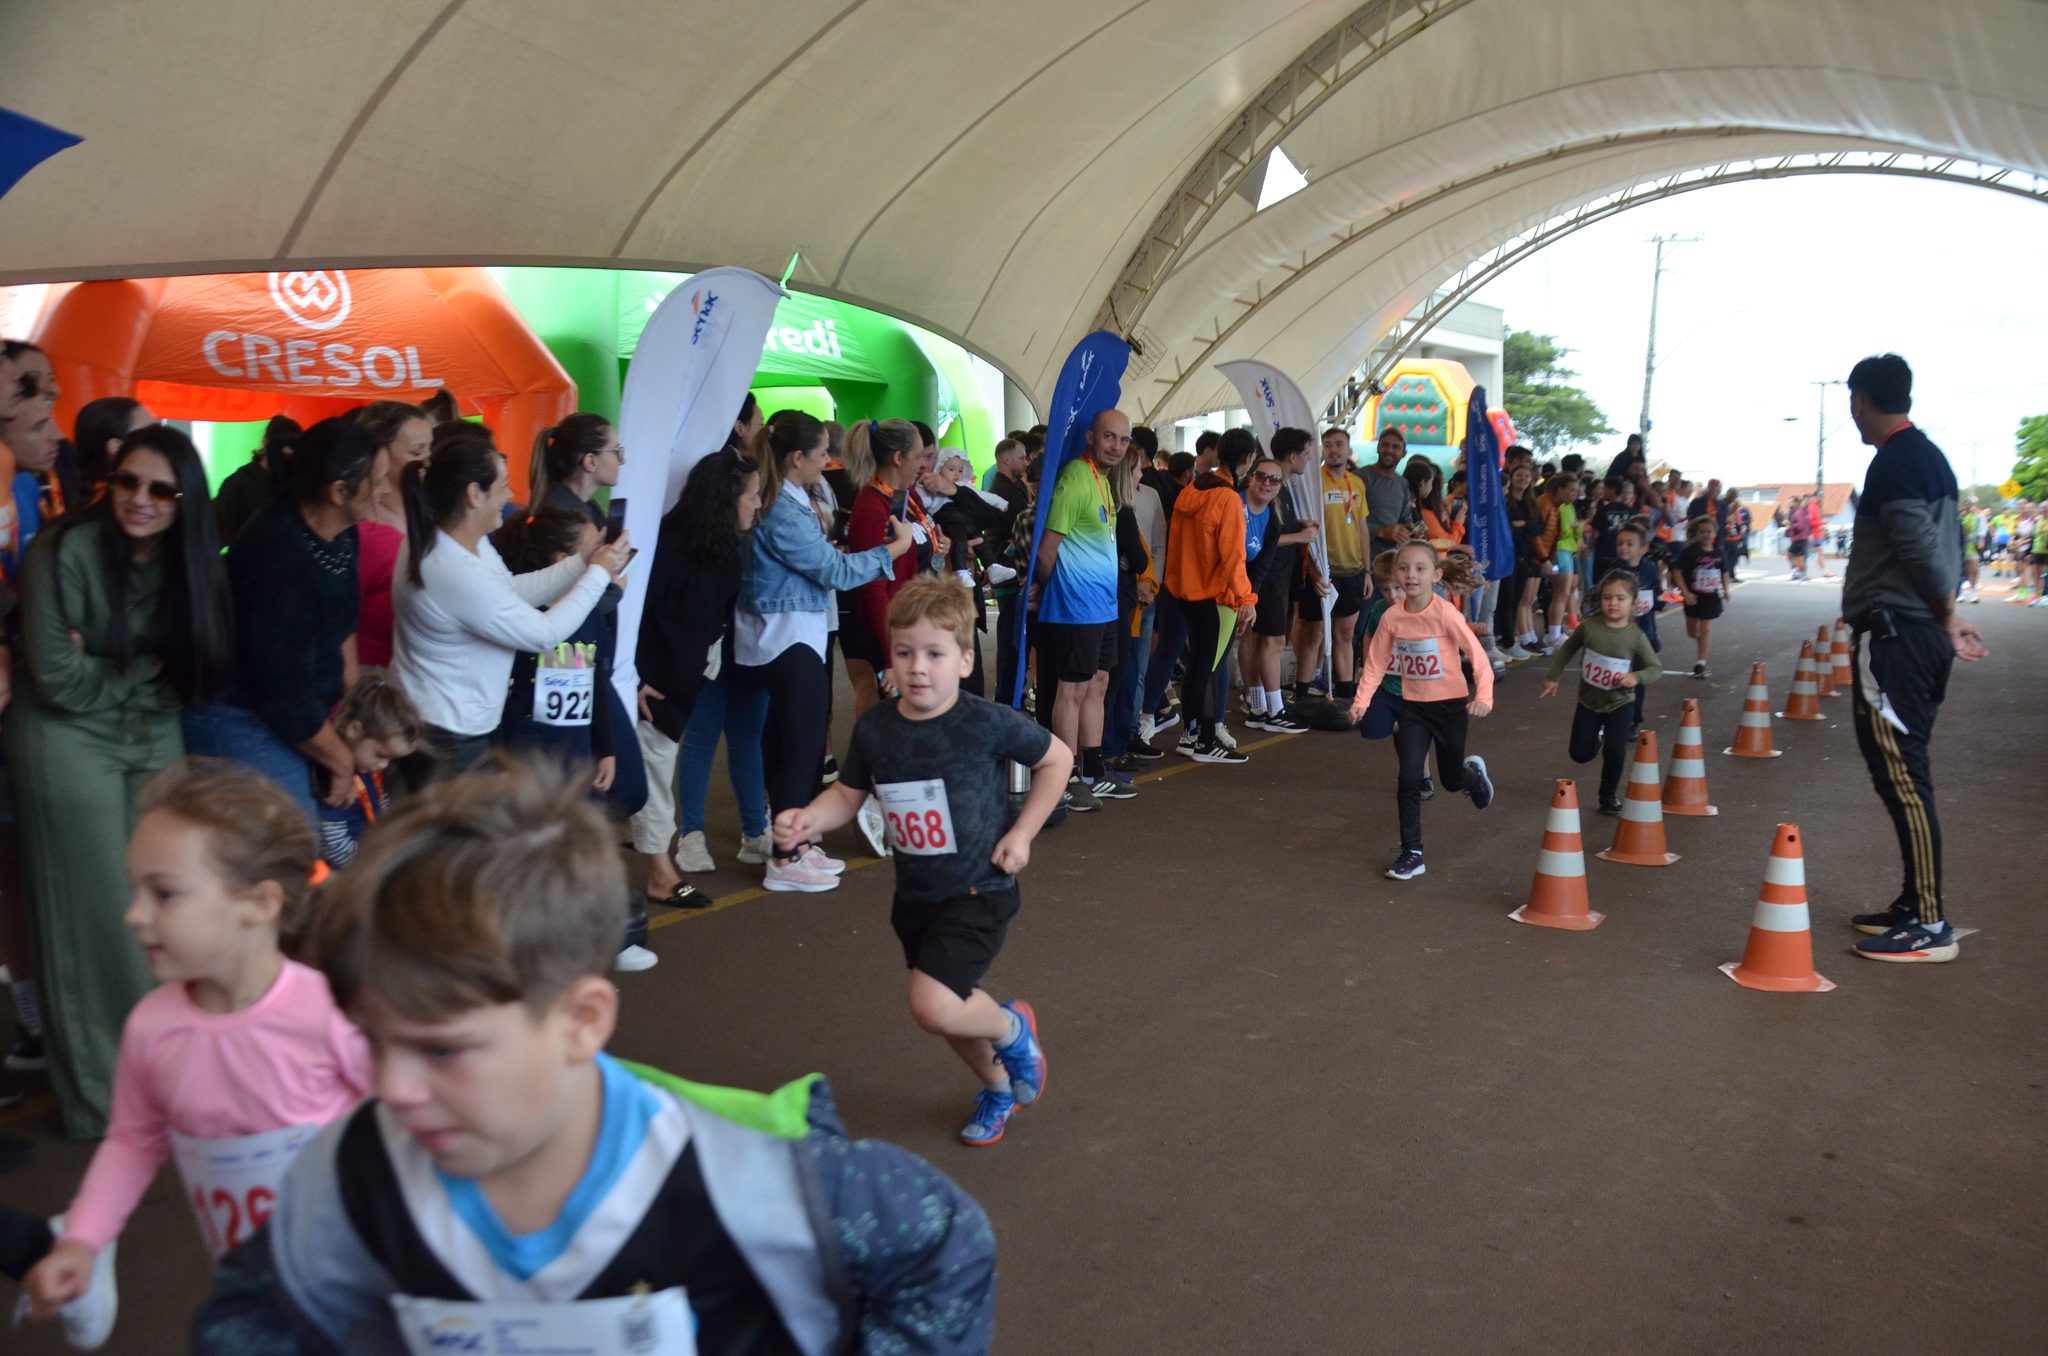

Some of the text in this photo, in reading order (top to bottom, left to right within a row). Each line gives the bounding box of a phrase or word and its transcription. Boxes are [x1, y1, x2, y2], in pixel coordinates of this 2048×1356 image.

[202, 330, 445, 388] CRESOL
[762, 320, 842, 360] redi
[886, 809, 947, 849] 368
